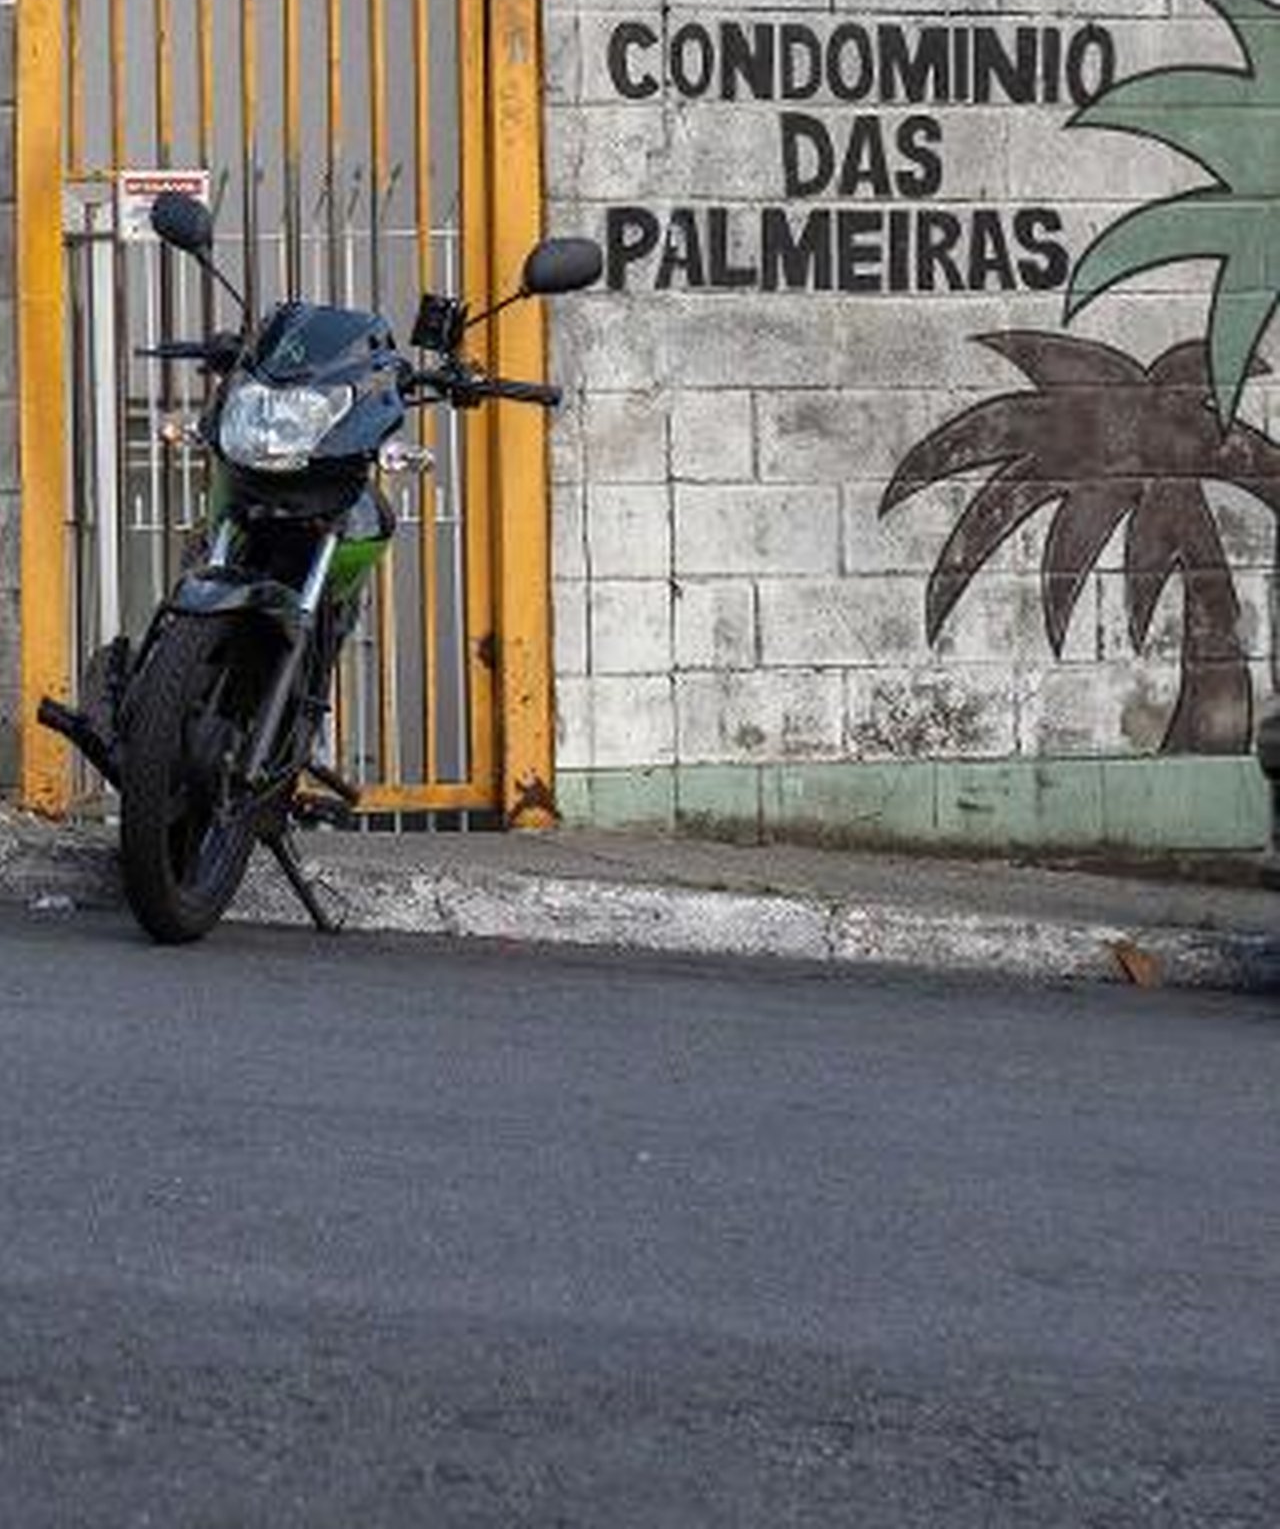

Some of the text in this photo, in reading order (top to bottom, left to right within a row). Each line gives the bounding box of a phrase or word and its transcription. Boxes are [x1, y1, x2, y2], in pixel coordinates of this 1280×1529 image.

[607, 22, 1117, 105] CONDOMINIO
[781, 112, 942, 198] DAS
[606, 207, 1070, 292] PALMEIRAS
